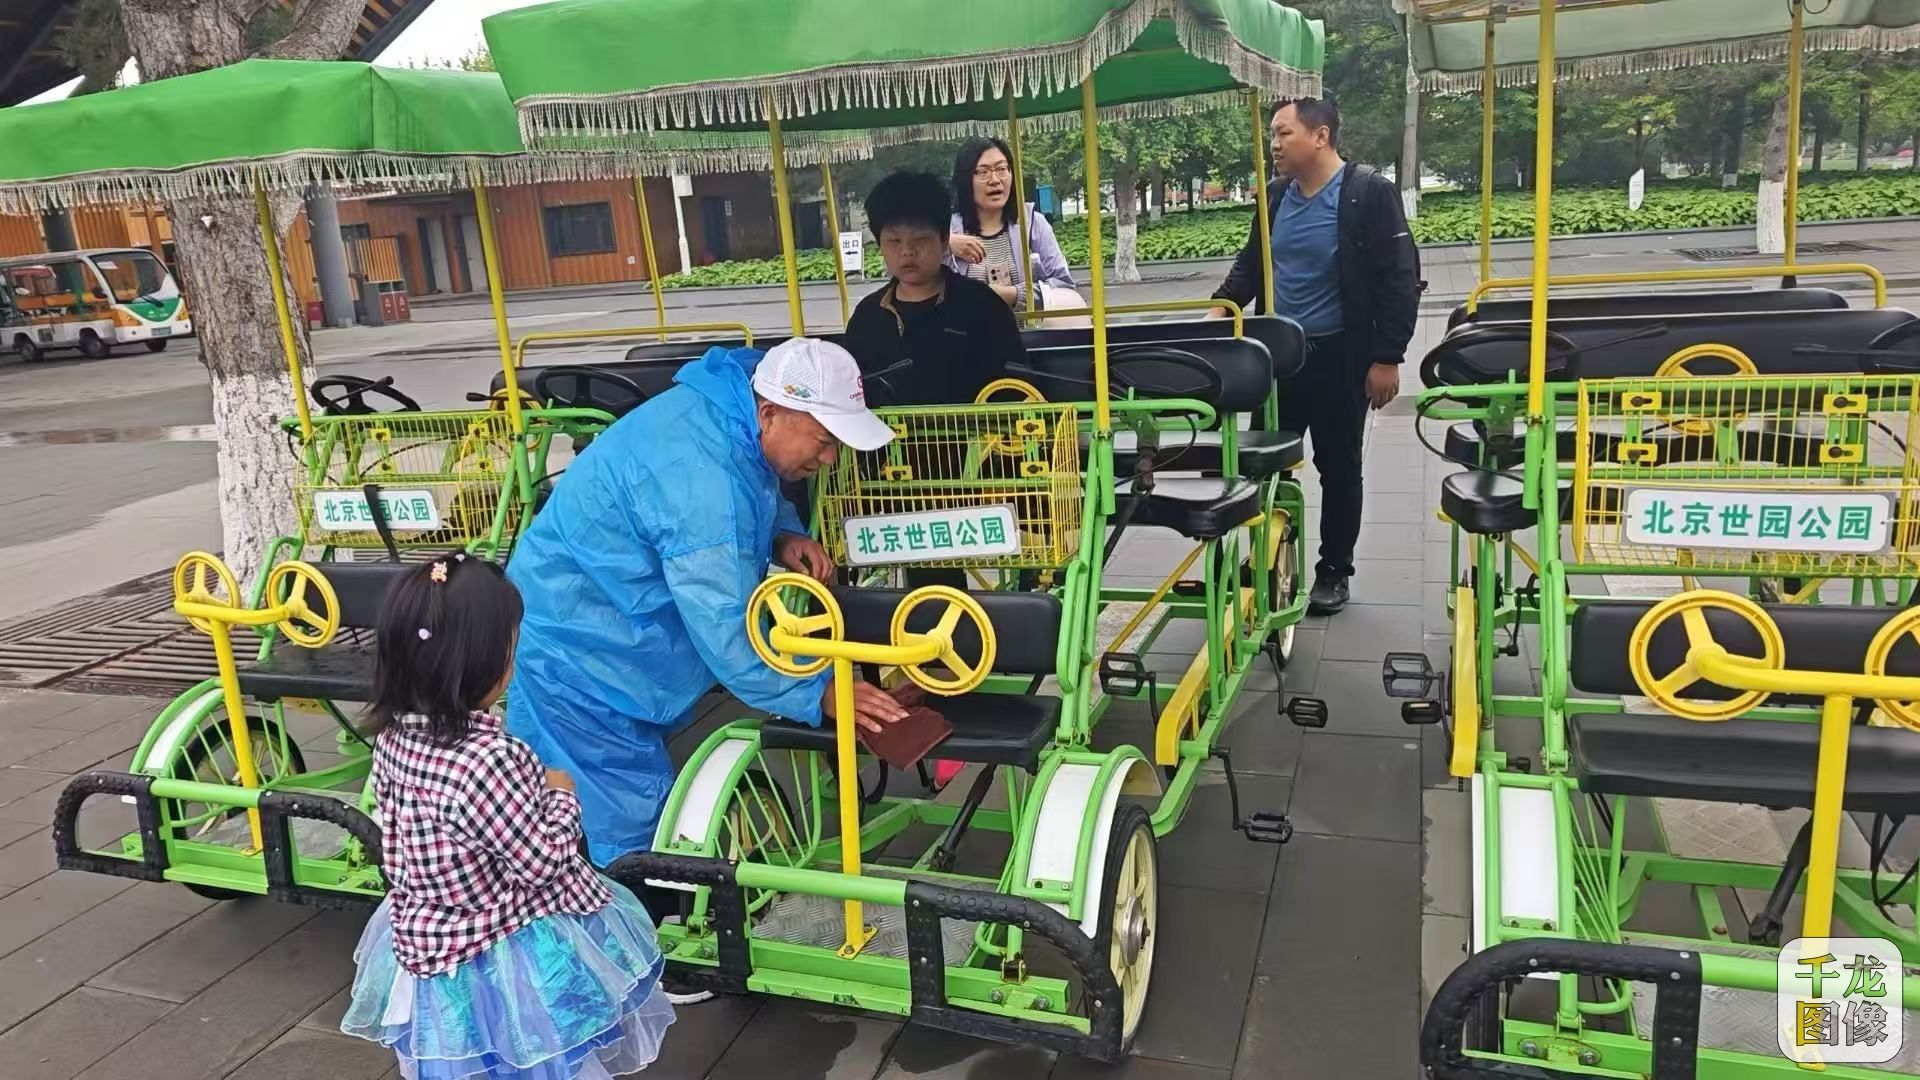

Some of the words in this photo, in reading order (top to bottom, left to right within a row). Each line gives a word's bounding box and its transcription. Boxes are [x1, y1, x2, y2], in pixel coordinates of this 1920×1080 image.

[843, 240, 859, 249] 出口
[857, 516, 1006, 555] 北京世园公园
[1642, 500, 1873, 541] 北京世园公园
